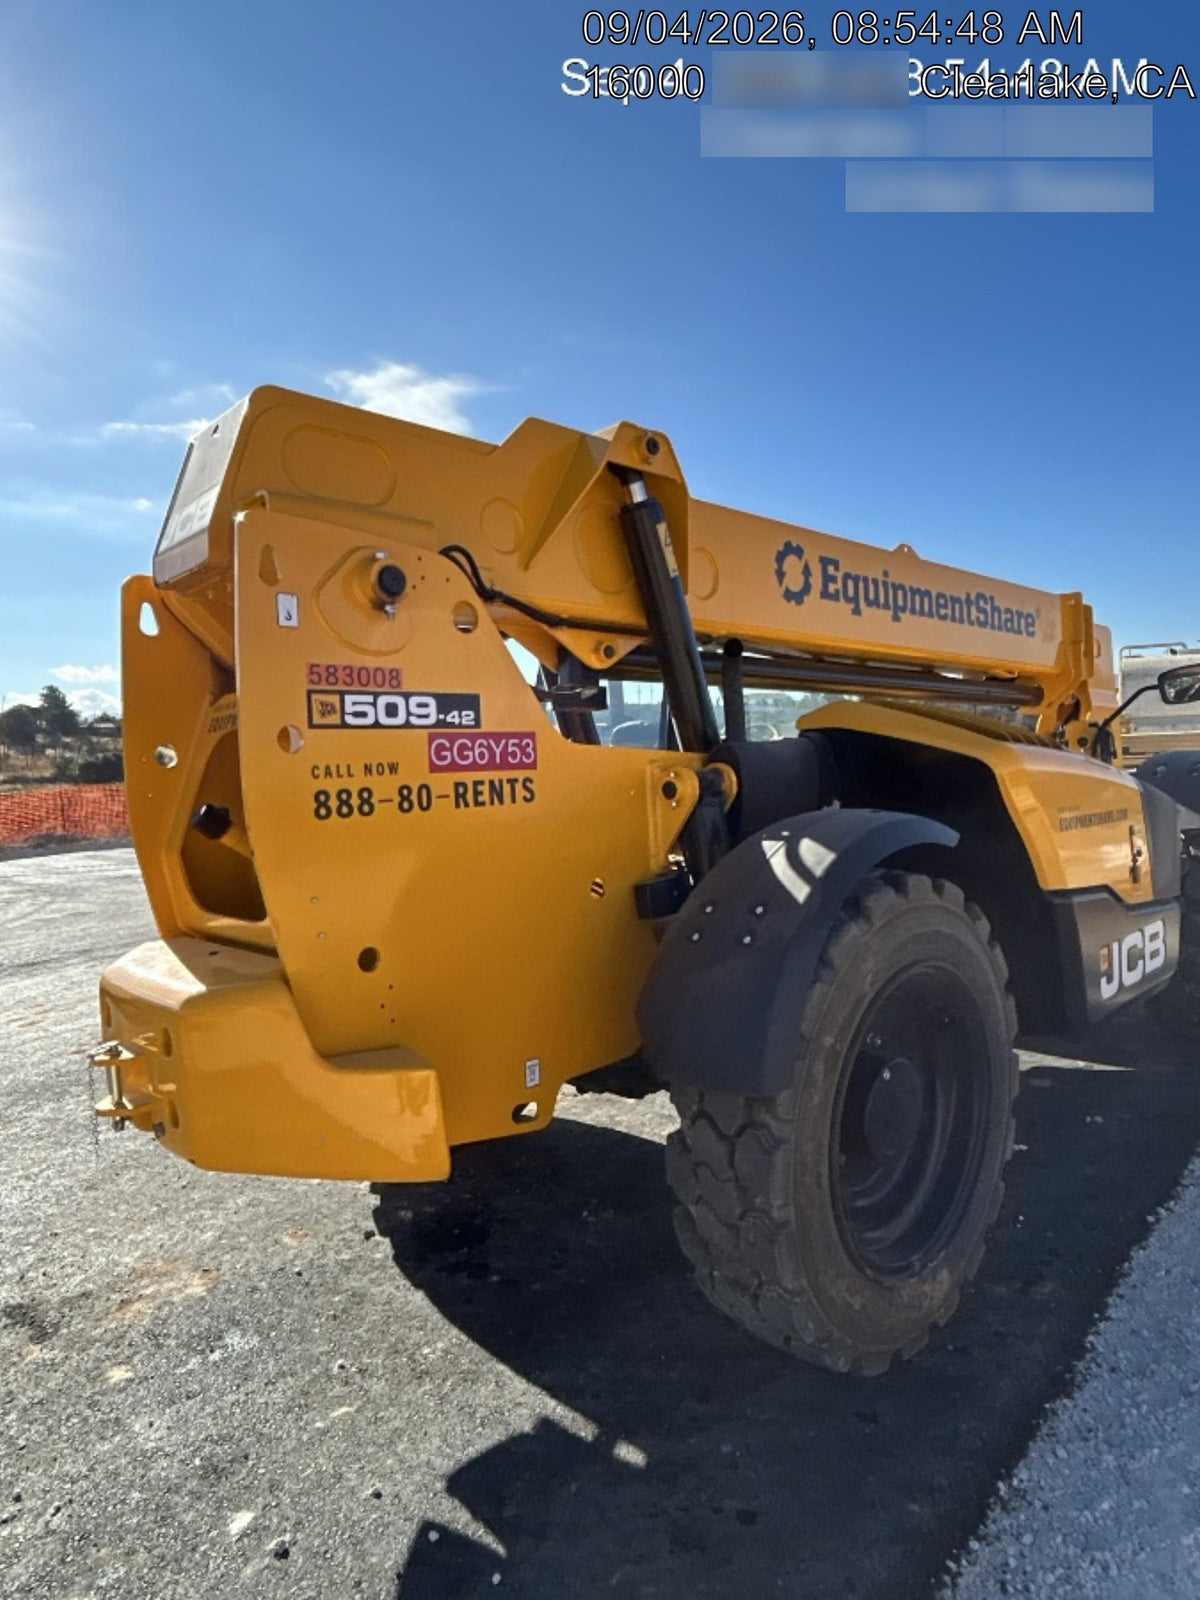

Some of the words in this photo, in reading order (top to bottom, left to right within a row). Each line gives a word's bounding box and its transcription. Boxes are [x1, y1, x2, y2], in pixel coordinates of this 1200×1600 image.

[818, 555, 1036, 637] EquipmentShare
[308, 663, 402, 689] 583008
[430, 738, 535, 766] GG6Y53
[311, 763, 354, 780] CALL
[364, 761, 400, 776] NOW
[313, 777, 536, 821] 888-80-RENTS
[1100, 919, 1166, 1000] JCB
